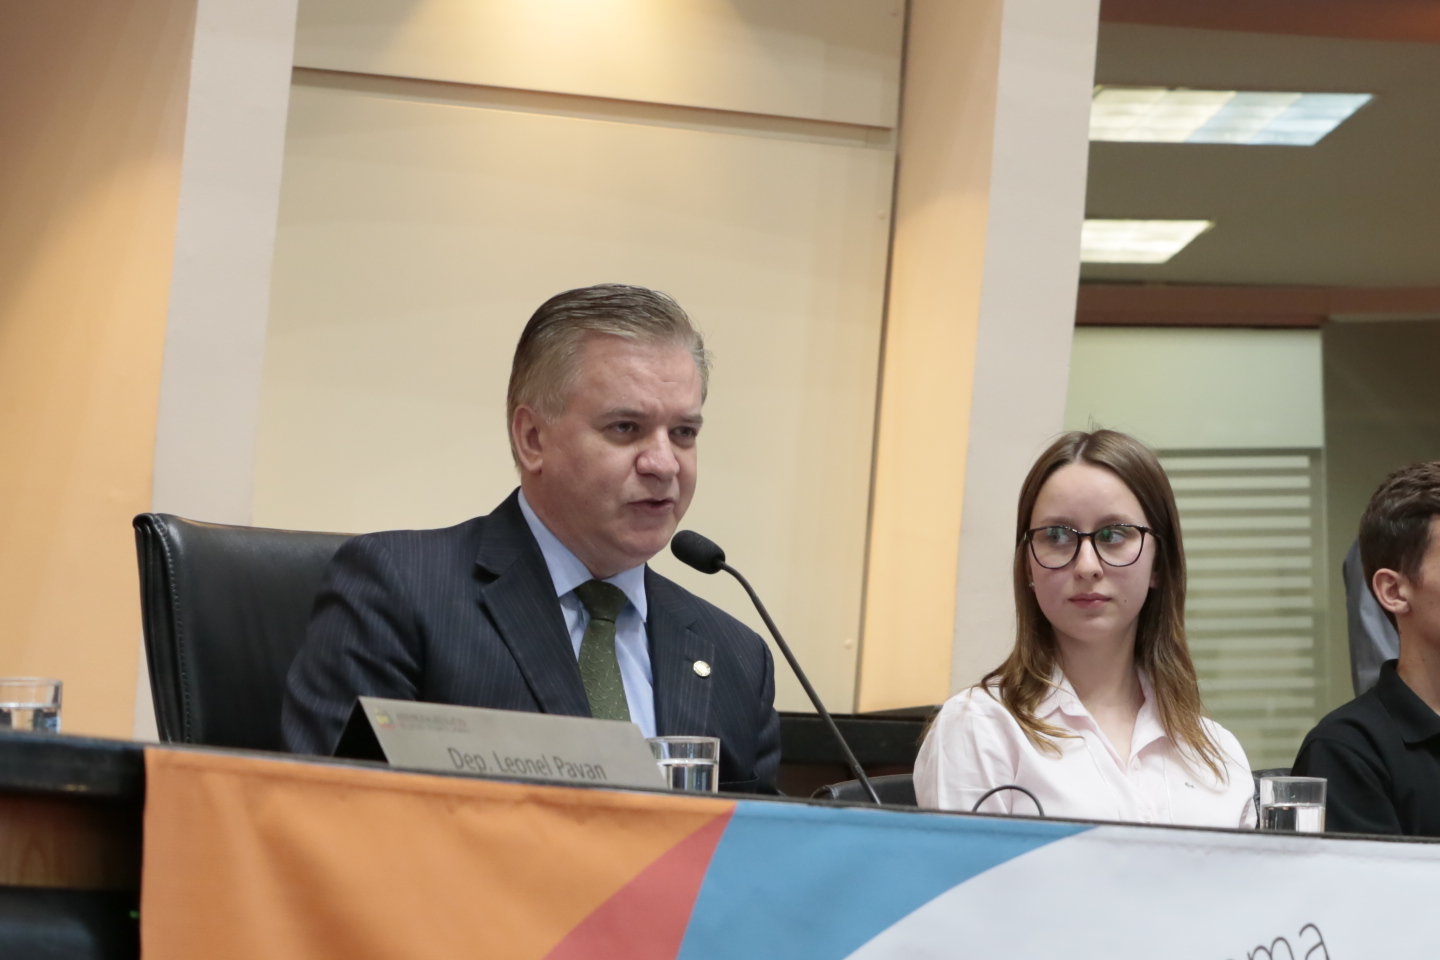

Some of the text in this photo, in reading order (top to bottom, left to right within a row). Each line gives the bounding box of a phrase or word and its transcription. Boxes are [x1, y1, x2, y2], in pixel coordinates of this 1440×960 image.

[447, 747, 607, 781] Dep. Leonel Pavan
